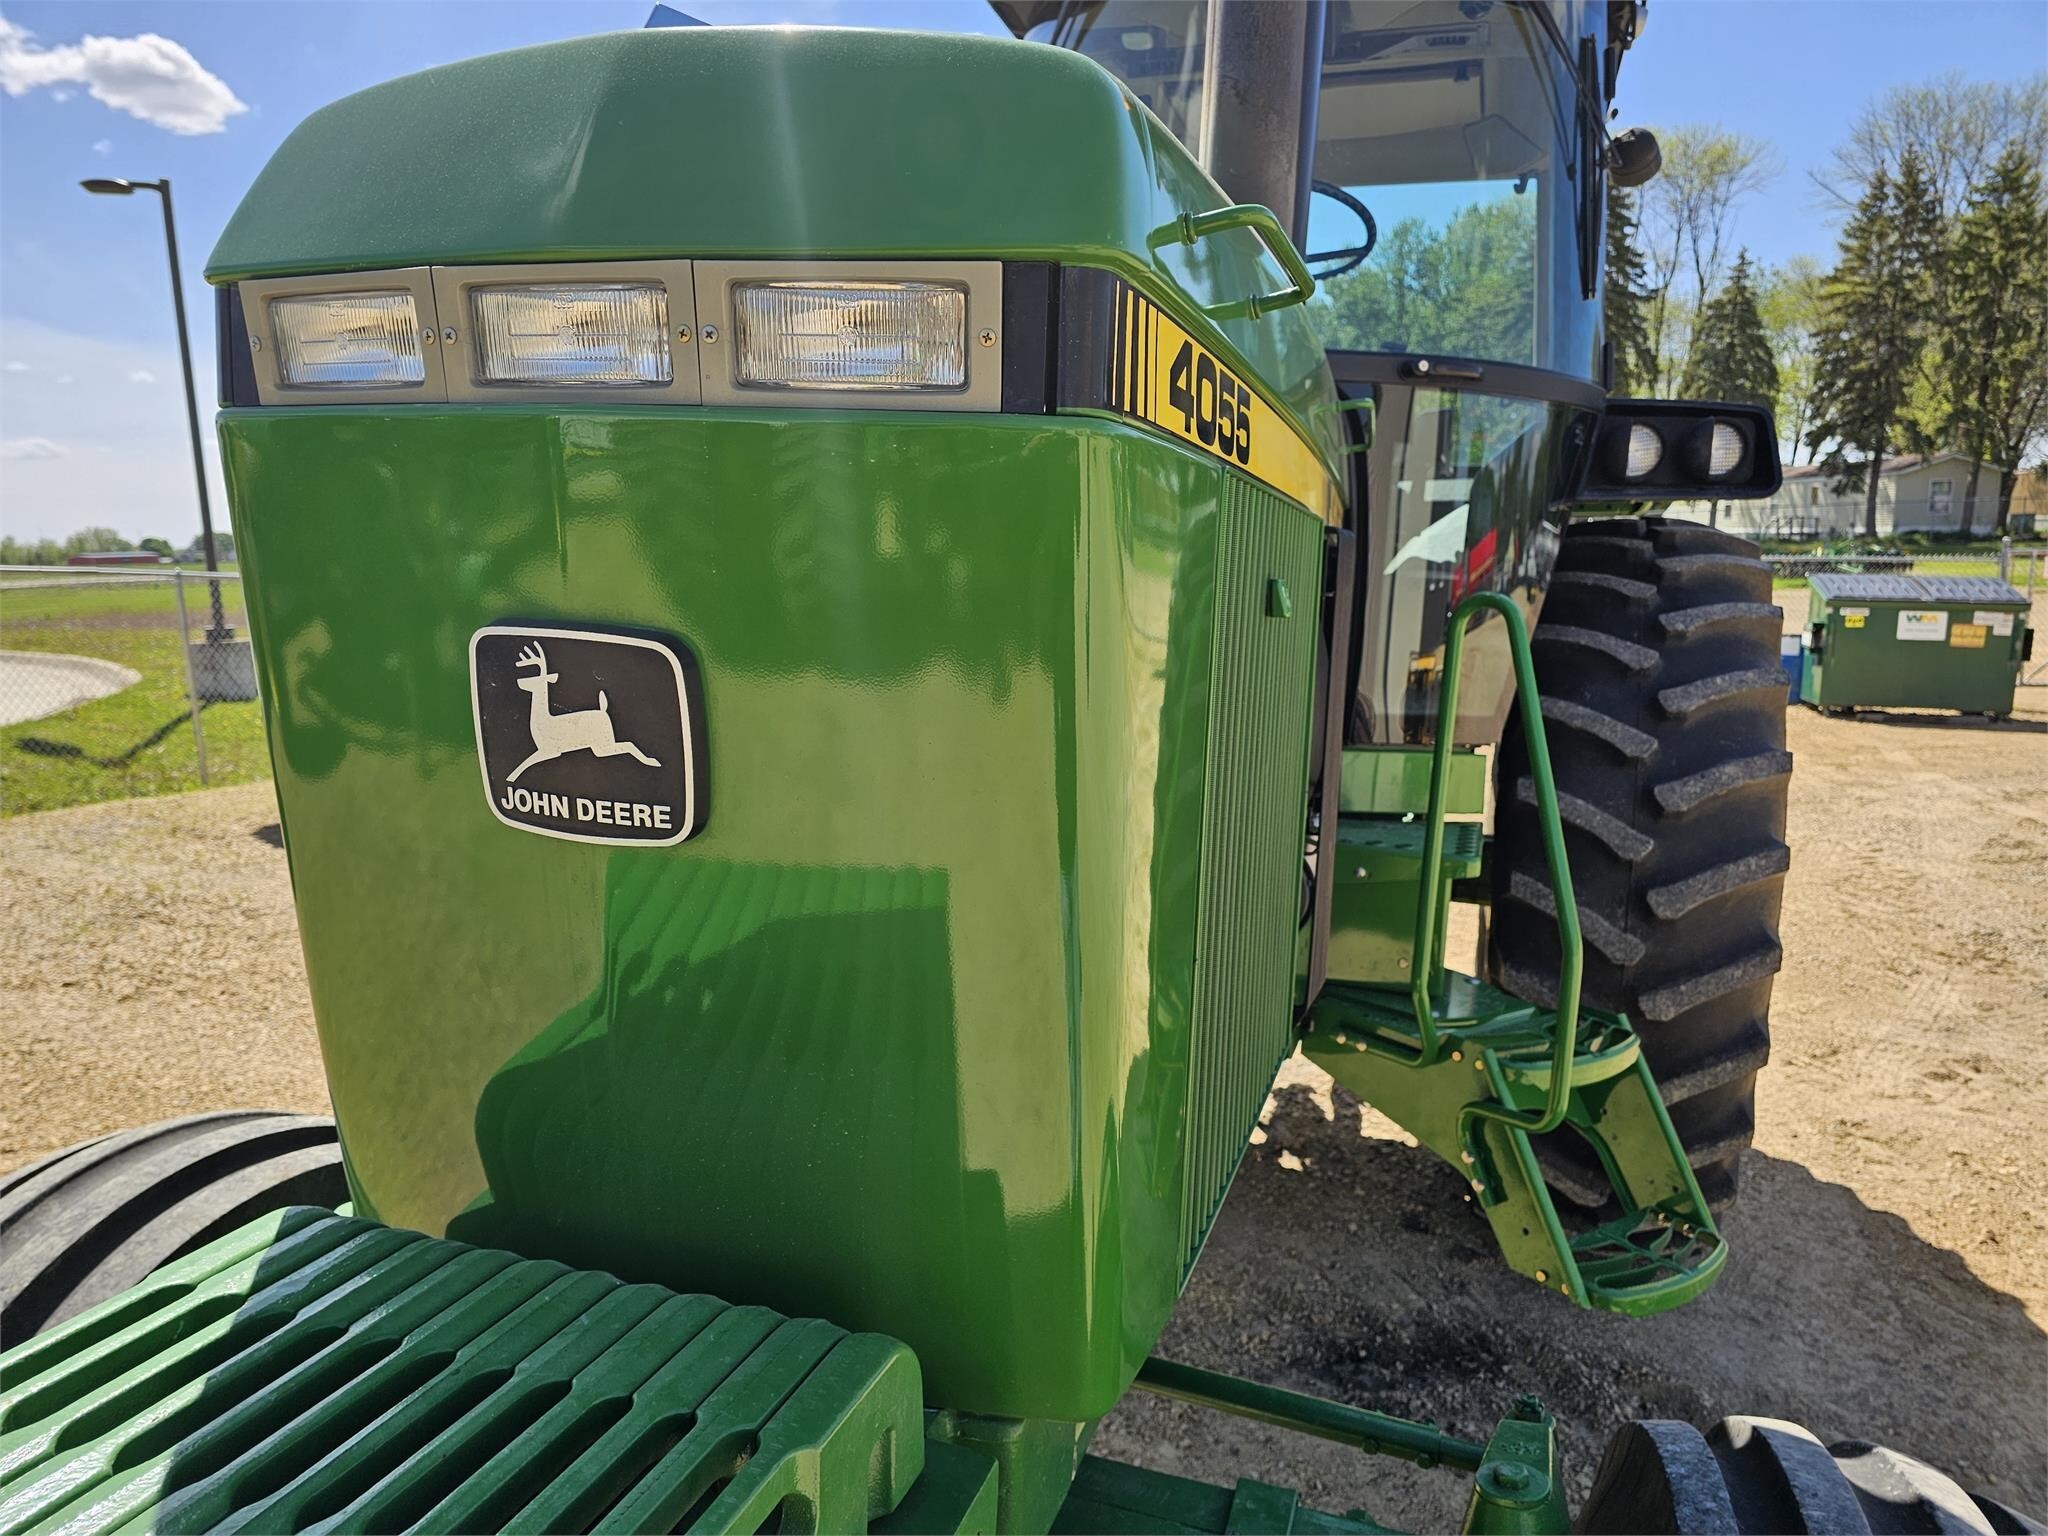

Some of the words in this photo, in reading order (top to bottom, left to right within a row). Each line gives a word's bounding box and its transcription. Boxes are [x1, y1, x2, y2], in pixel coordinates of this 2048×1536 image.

[1169, 339, 1251, 465] 4055
[501, 786, 570, 819] JOHN
[576, 798, 672, 829] DEERE
